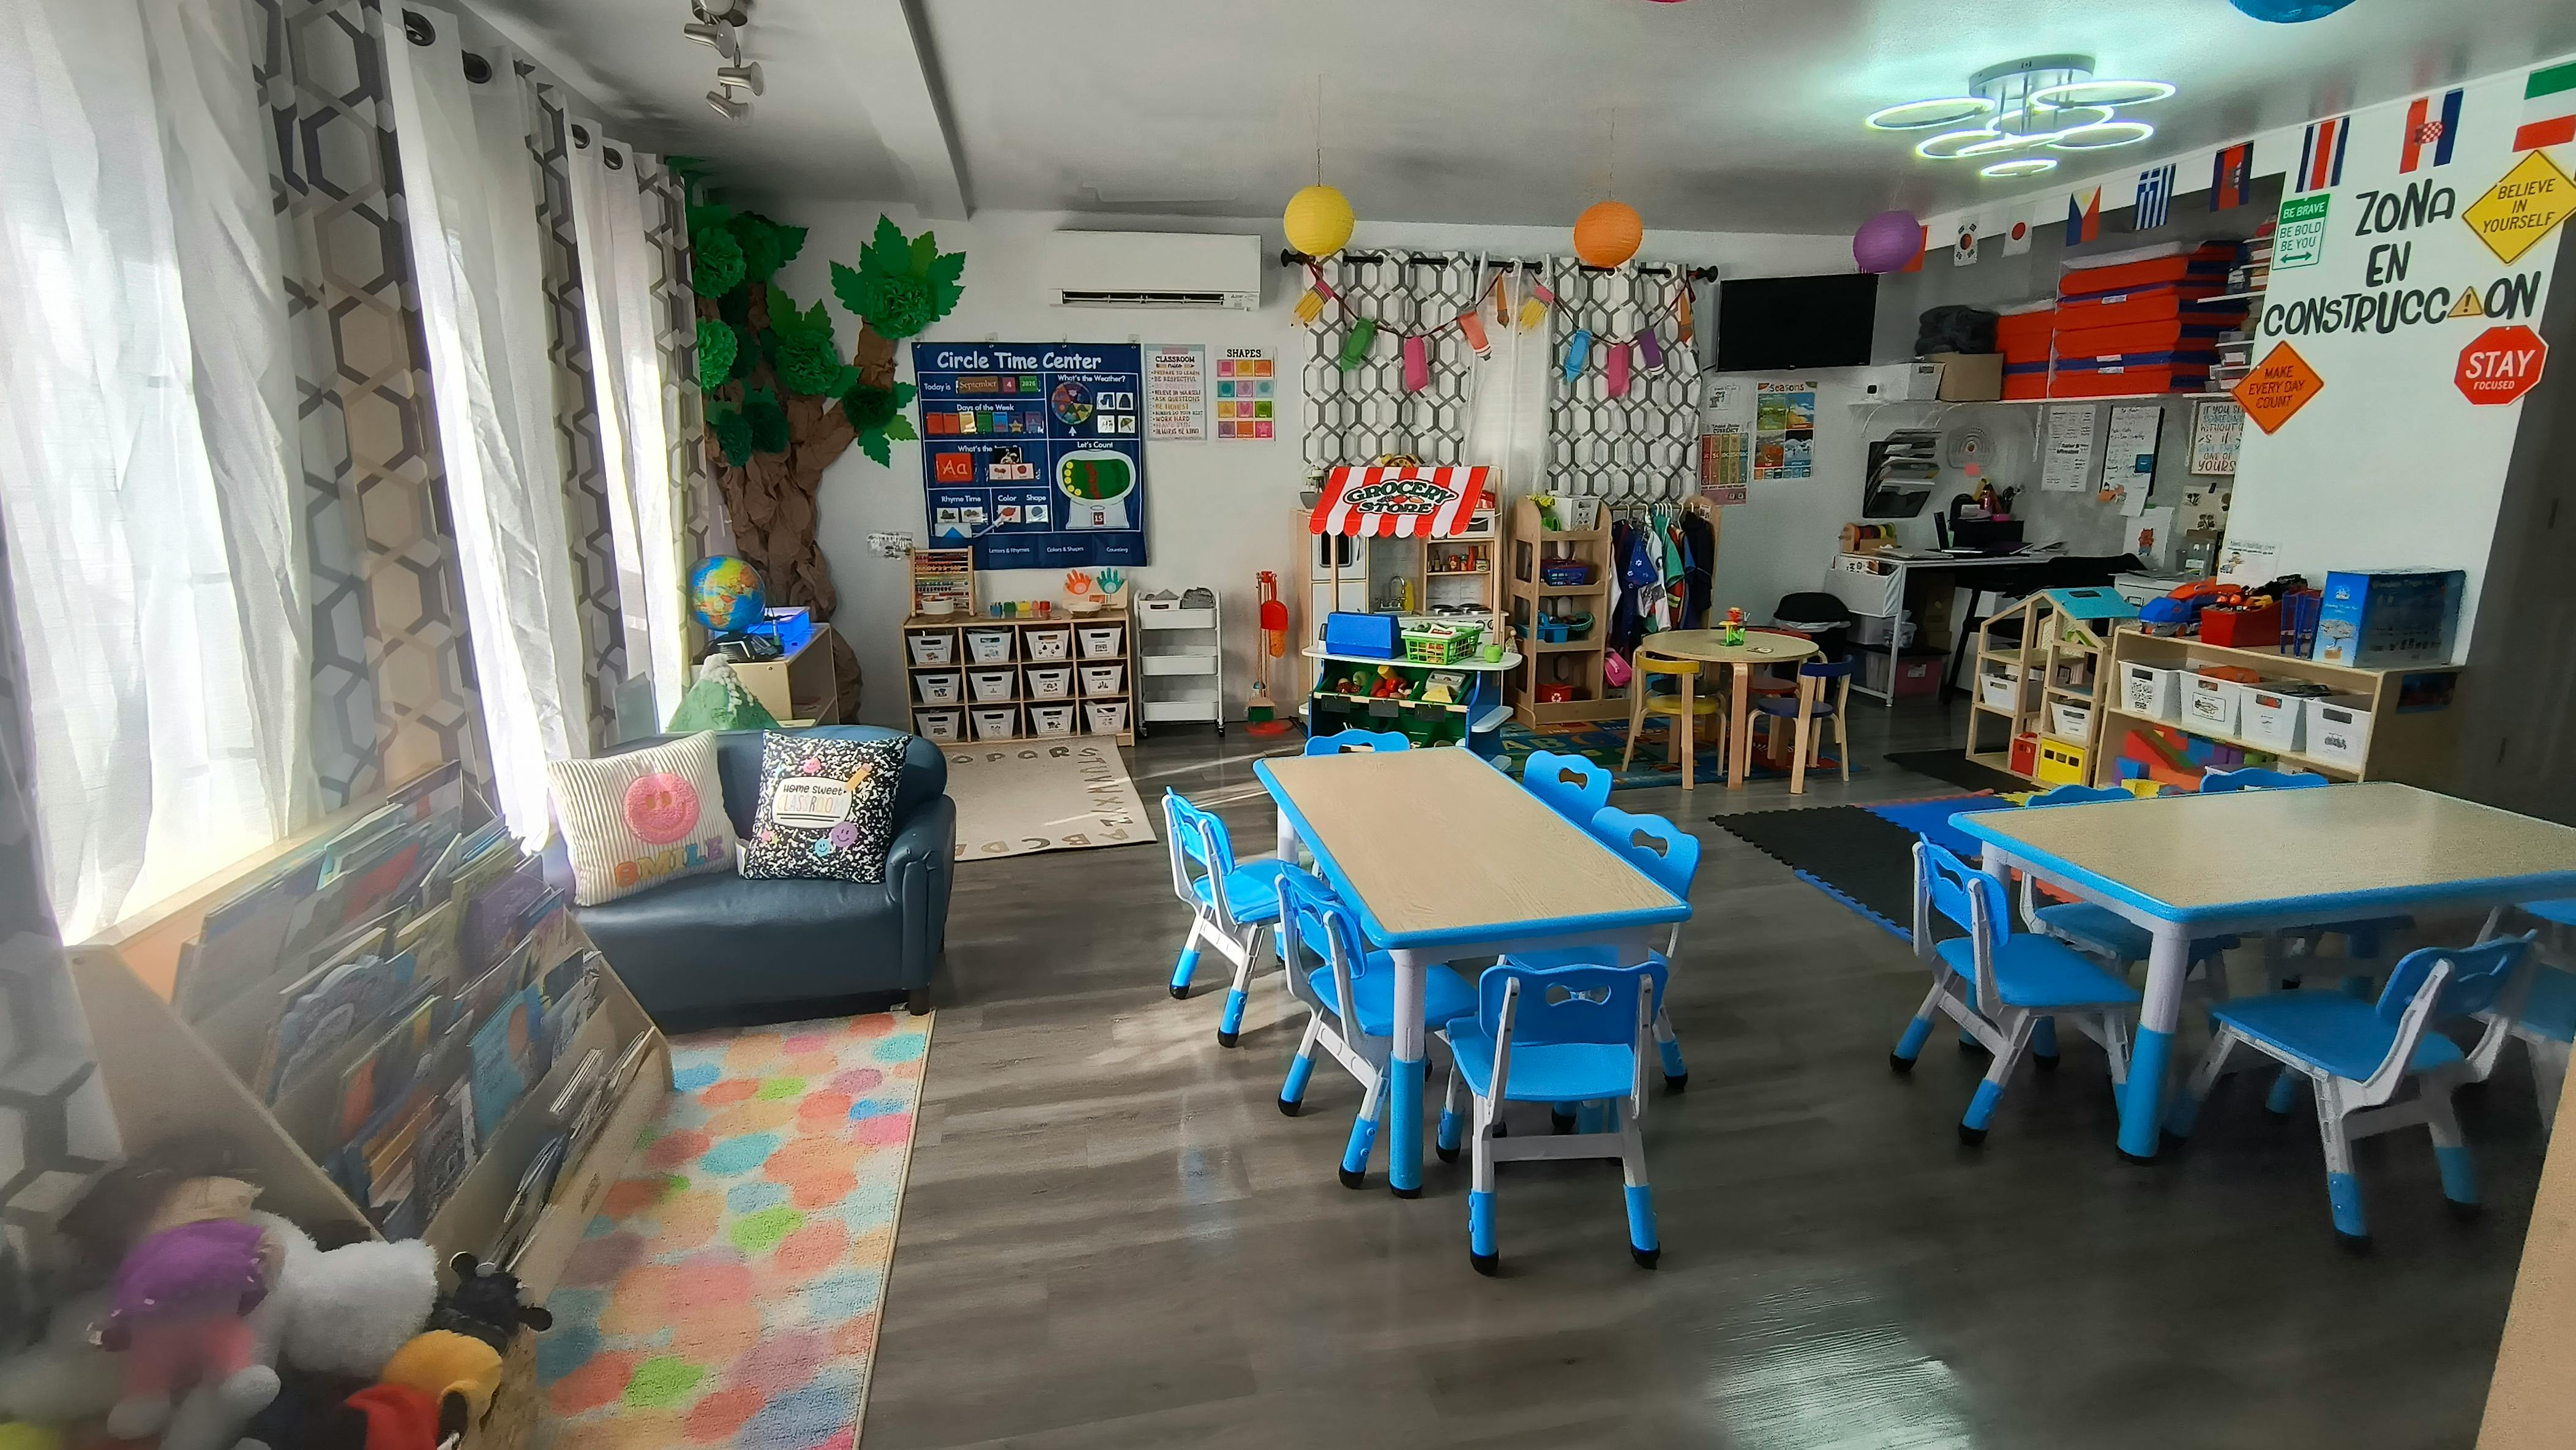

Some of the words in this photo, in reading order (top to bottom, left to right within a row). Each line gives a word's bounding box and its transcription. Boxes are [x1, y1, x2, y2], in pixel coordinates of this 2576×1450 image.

[2497, 178, 2556, 200] BELIEVE
[2283, 207, 2296, 219] BE
[2296, 202, 2326, 217] BRAVE
[2355, 178, 2456, 236] ZONA
[2512, 199, 2528, 214] IN
[2280, 226, 2293, 238] BE
[2295, 222, 2321, 236] BOLD
[2483, 211, 2556, 233] YOURSELF
[2280, 240, 2293, 252] BE
[2296, 236, 2316, 249] YOU
[2365, 241, 2411, 287] EN
[937, 351, 989, 369] Circle
[994, 352, 1038, 369] Time
[1043, 352, 1102, 369] Center
[1227, 349, 1261, 358] SHAPES
[2264, 365, 2294, 378] MAKE
[2465, 349, 2536, 379] STAY
[924, 383, 943, 392] Today
[959, 381, 997, 390] September
[2248, 381, 2283, 396] EVERY
[2284, 380, 2306, 393] DAY
[2473, 380, 2515, 391] FOCUSED
[2213, 405, 2230, 414] YOU
[2255, 395, 2293, 409] COUNT
[943, 459, 968, 475] Aa
[2198, 460, 2236, 471] YOURS
[1347, 481, 1456, 503] GROCERY
[1359, 502, 1433, 514] STORE
[1502, 740, 1533, 750] A
[986, 753, 1005, 761] P
[1049, 746, 1070, 757] R
[777, 795, 845, 813] CLASSROOM
[615, 836, 725, 887] SMILE
